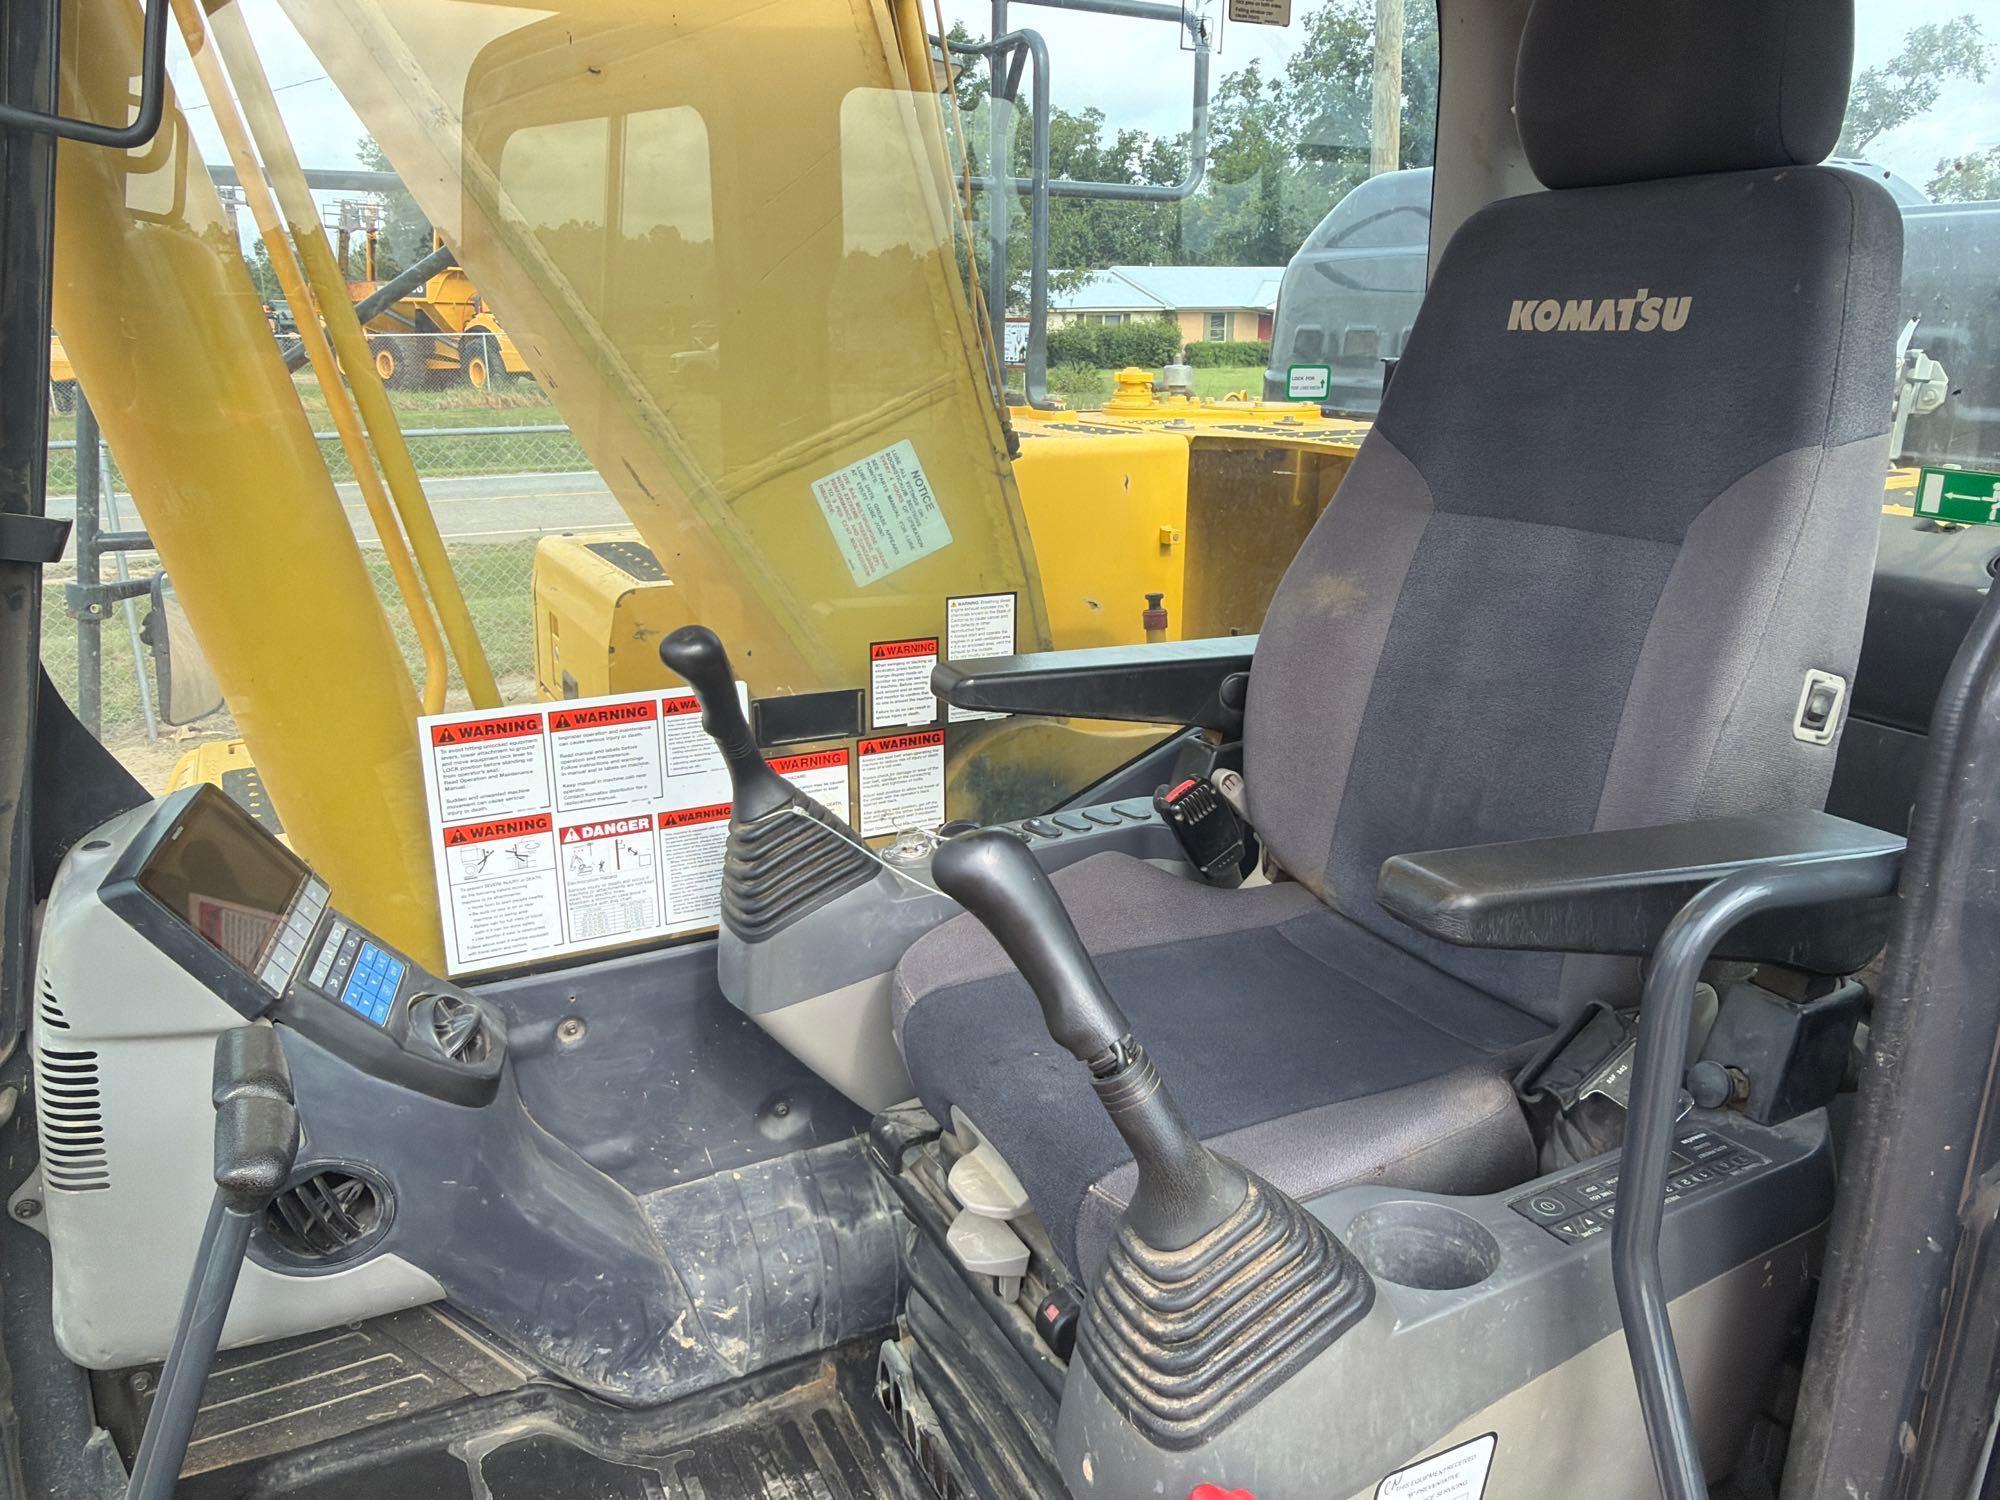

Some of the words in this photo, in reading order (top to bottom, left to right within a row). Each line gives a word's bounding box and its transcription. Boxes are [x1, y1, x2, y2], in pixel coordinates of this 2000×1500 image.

[1506, 288, 1693, 332] KOMATSU
[910, 470, 935, 512] NOTICE
[887, 643, 935, 656] WARNING
[574, 706, 648, 725] WARNING
[459, 719, 538, 739] WARNING
[880, 734, 940, 750] WARNING
[780, 754, 840, 770] WARNING
[678, 807, 731, 822] WARNING
[470, 818, 547, 839] WARNING
[582, 818, 650, 838] DANGER
